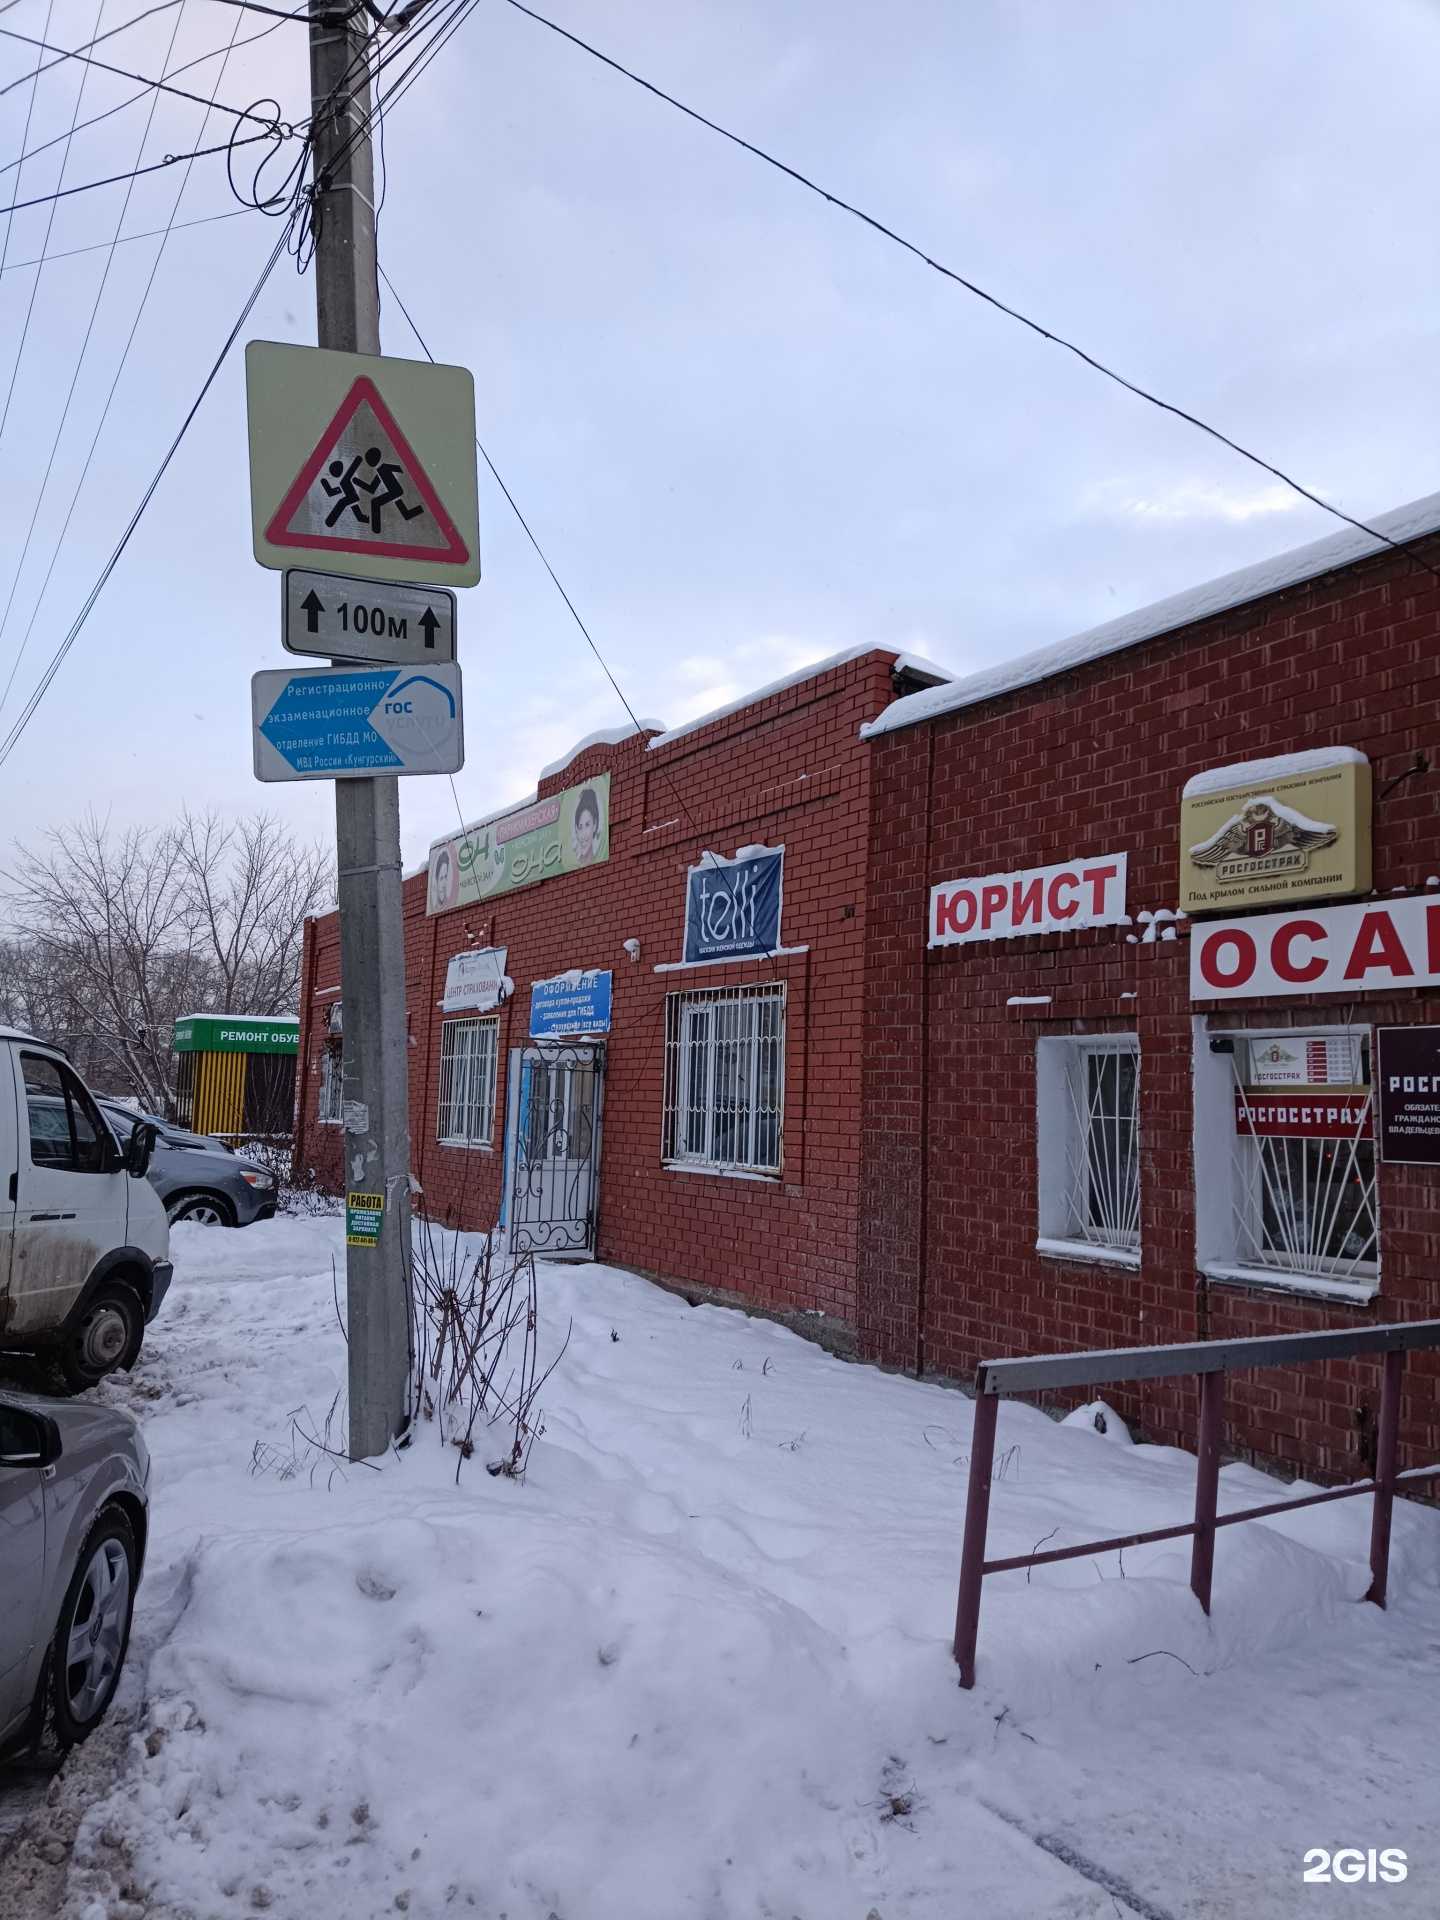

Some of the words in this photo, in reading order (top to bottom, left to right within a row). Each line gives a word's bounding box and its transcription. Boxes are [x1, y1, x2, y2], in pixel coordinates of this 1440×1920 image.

[268, 705, 370, 724] экзаменационное
[276, 735, 324, 751] отделение
[327, 731, 360, 746] ГИБДД
[363, 731, 378, 743] МО
[296, 757, 313, 769] МВД
[314, 755, 342, 767] России
[1222, 854, 1301, 875] РОСГОССТРАХ
[1188, 891, 1207, 902] Под
[1209, 886, 1245, 901] крылом
[1248, 879, 1288, 894] сильной
[1291, 873, 1343, 888] компании
[936, 864, 1118, 936] ЮРИСТ
[1200, 904, 1440, 989] ОСА
[220, 1031, 268, 1042] РЕМОНТ
[1238, 1106, 1368, 1125] РОСГОССТРАХ
[351, 1195, 381, 1208] РАБОТА
